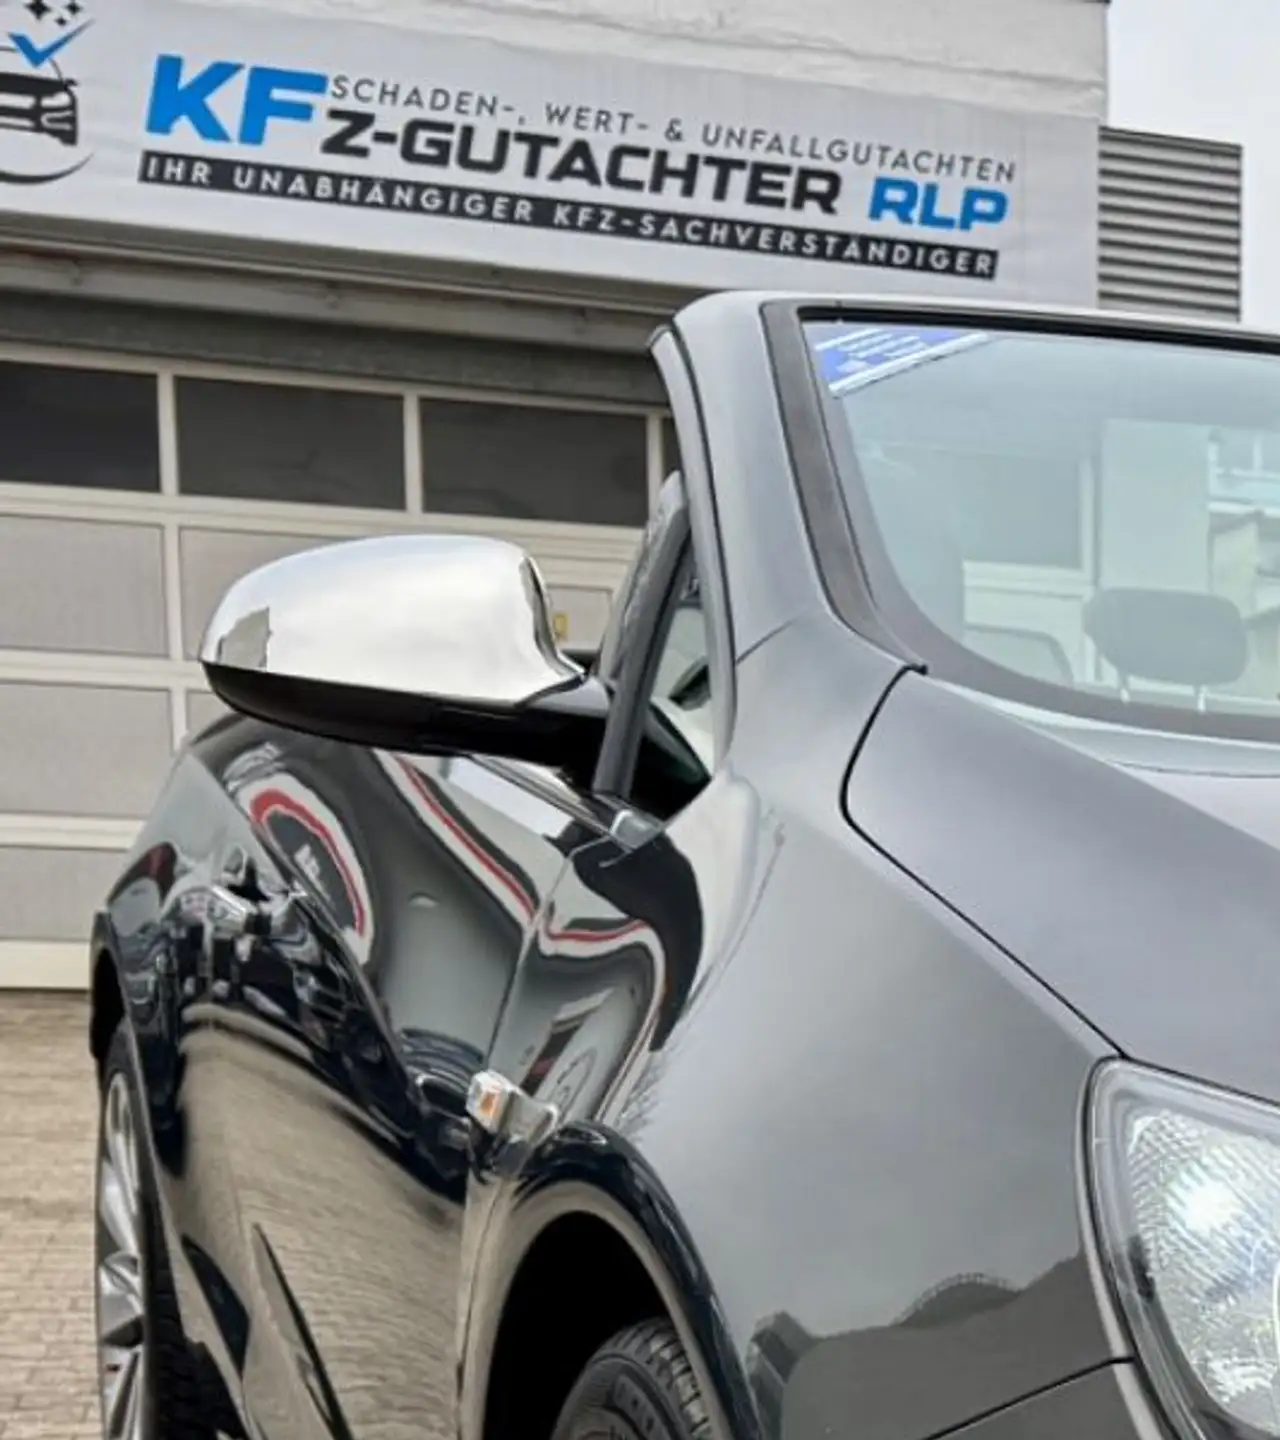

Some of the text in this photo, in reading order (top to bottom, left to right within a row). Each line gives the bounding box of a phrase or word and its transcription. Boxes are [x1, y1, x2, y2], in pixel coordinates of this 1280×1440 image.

[331, 75, 1016, 183] SCHADEN-, WERT- & UNFALLGUTACHTEN
[146, 156, 994, 277] IHR UNABHÄNGIGER KFZ-SACHVERSTÄNDIGER
[867, 175, 1010, 232] RLP
